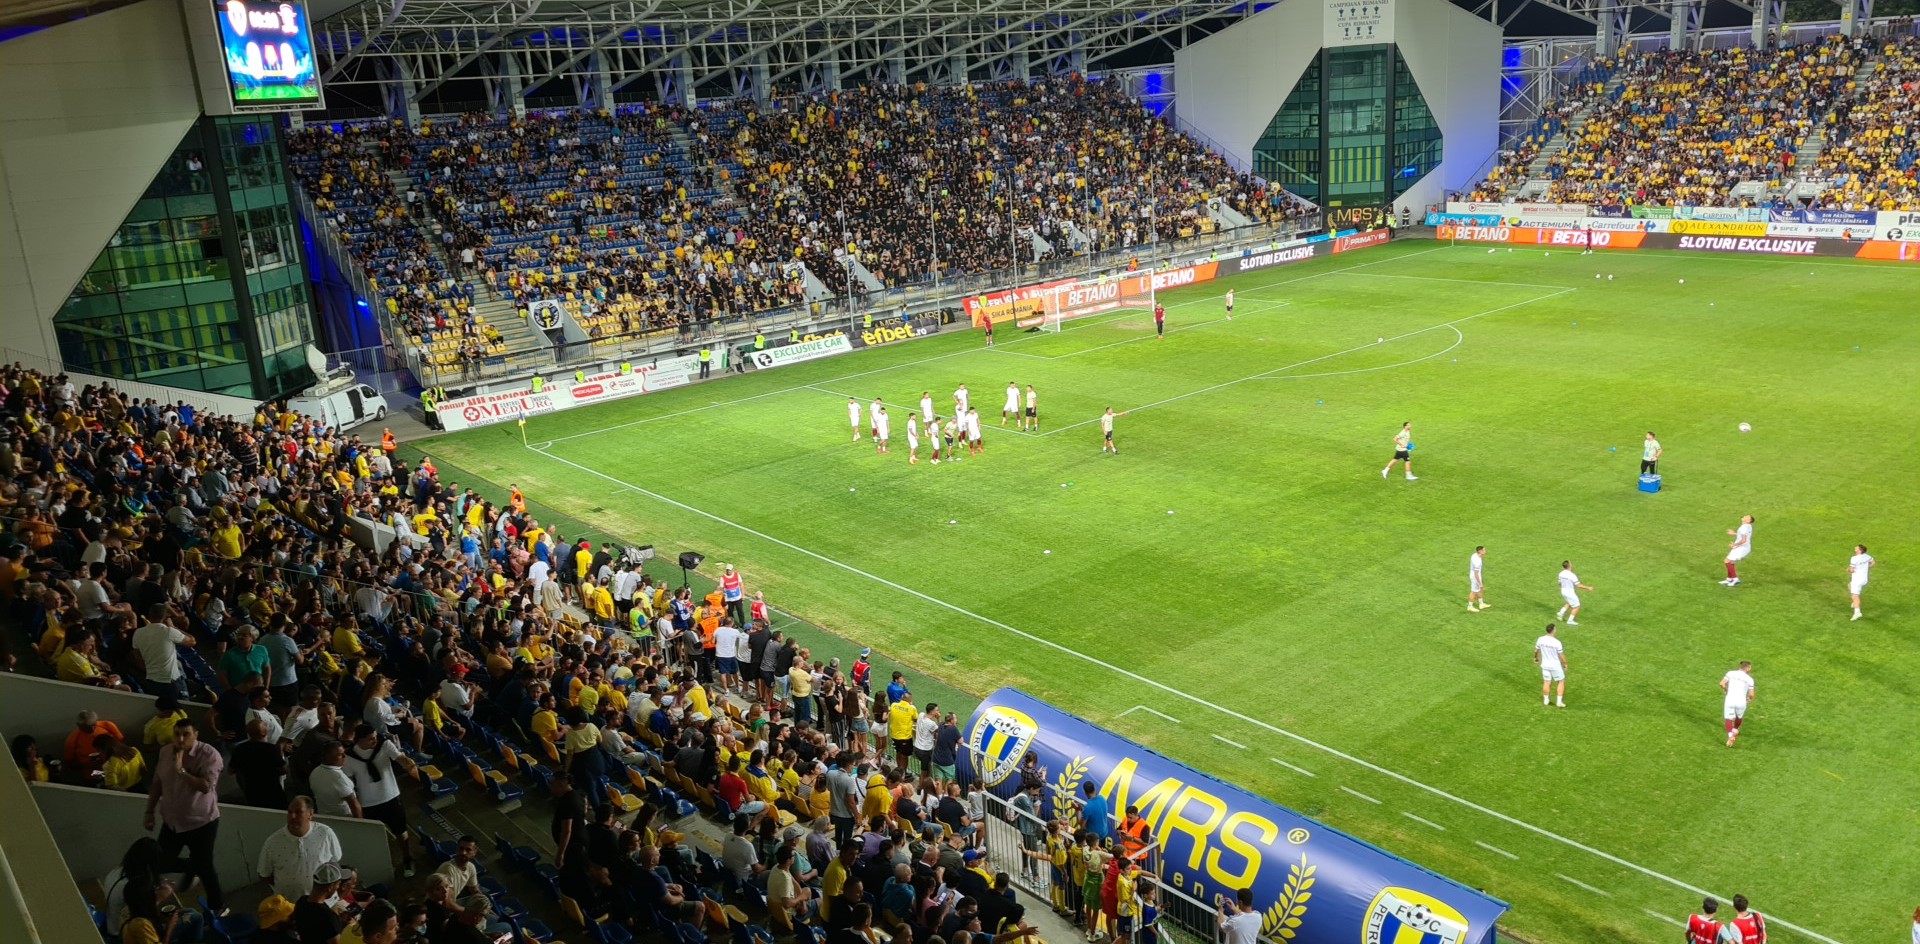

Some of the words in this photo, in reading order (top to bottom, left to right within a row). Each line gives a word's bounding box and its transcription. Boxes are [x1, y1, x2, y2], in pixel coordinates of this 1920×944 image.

[1455, 226, 1510, 241] BETANO
[1522, 221, 1572, 229] ACTEMIUM
[1592, 220, 1636, 230] Carrefour
[1689, 222, 1764, 231] ALEXANDRION
[1679, 236, 1738, 250] SLOTURI
[1738, 238, 1817, 253] EXCLUSIVE
[1240, 254, 1273, 270] SLOTURI
[1273, 245, 1315, 263] EXCLUSIVE
[1153, 268, 1196, 289] BETANO
[1067, 282, 1118, 307] BETANO
[773, 340, 823, 359] EXCLUSIVE
[824, 337, 844, 350] CAR
[1099, 757, 1279, 892] MRS
